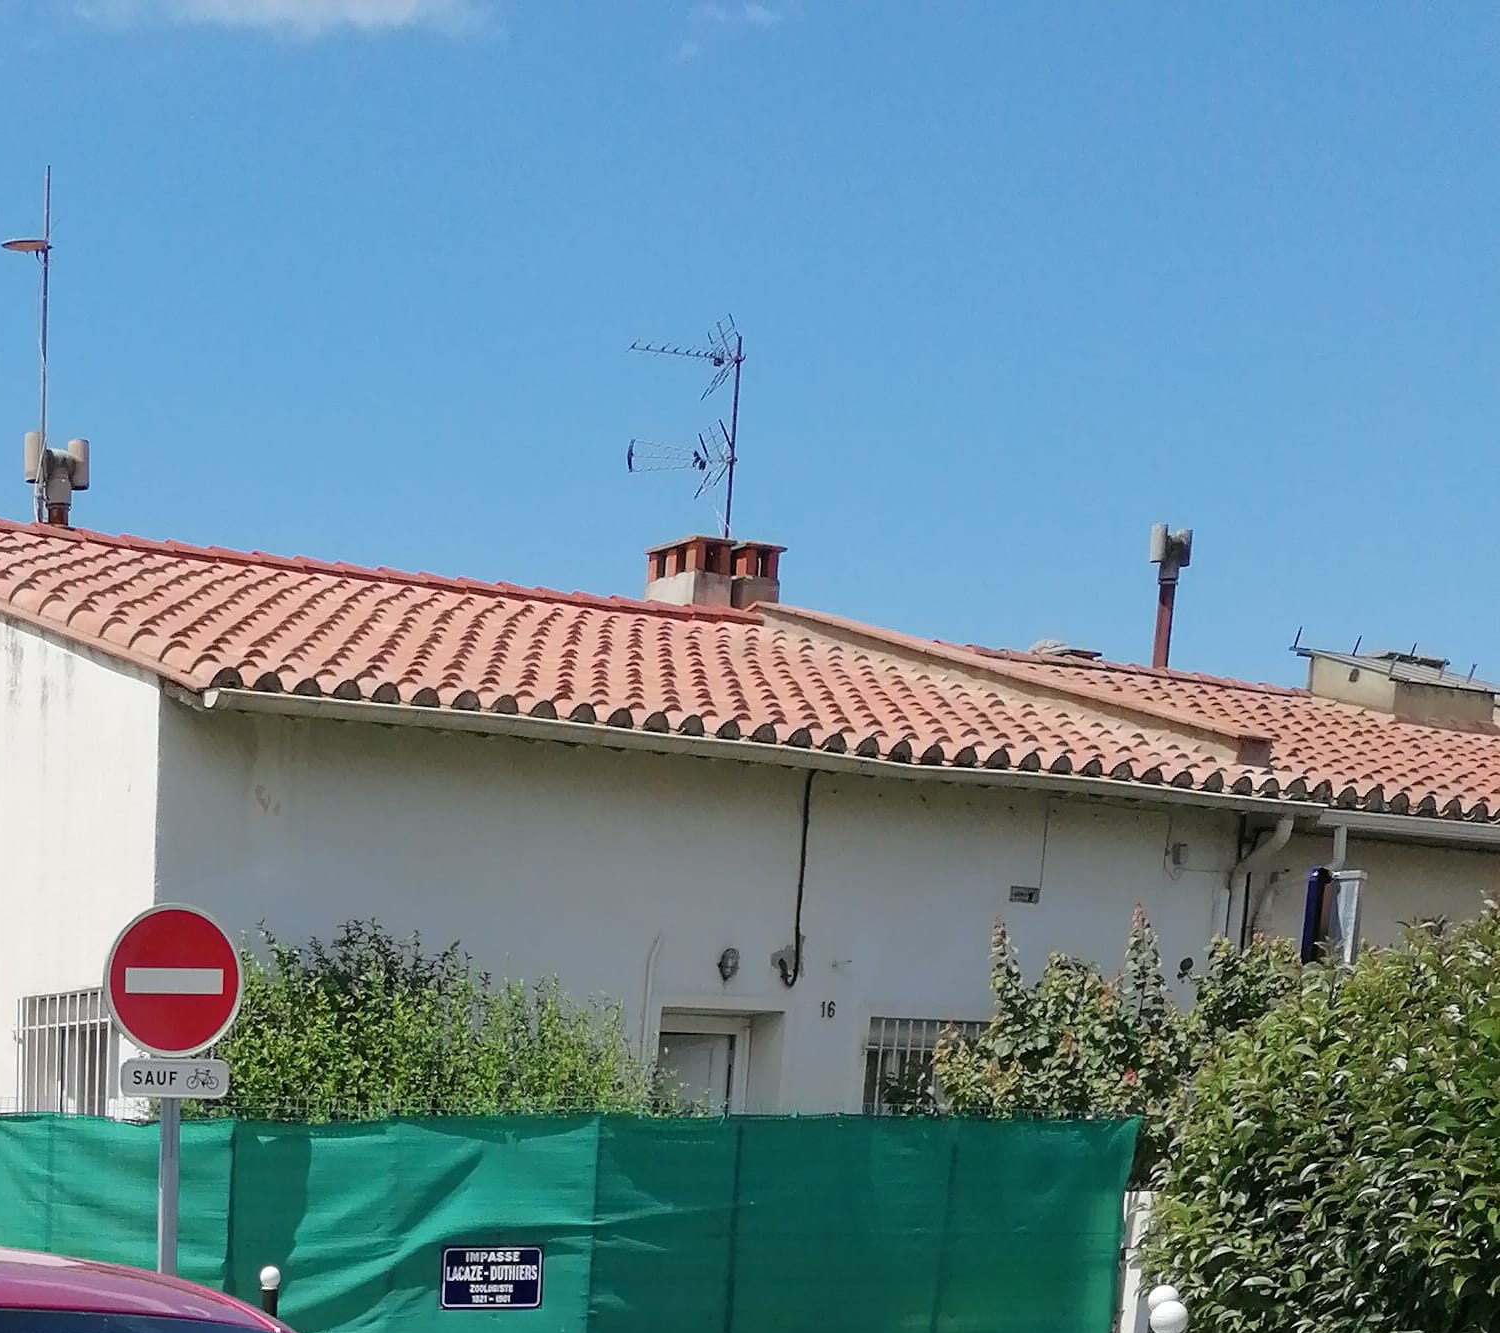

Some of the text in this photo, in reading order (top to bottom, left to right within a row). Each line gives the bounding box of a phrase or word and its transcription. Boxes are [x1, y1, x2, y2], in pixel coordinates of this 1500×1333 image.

[820, 1001, 836, 1018] 16
[132, 1070, 178, 1086] SAUF
[465, 1251, 521, 1263] IMPASSE
